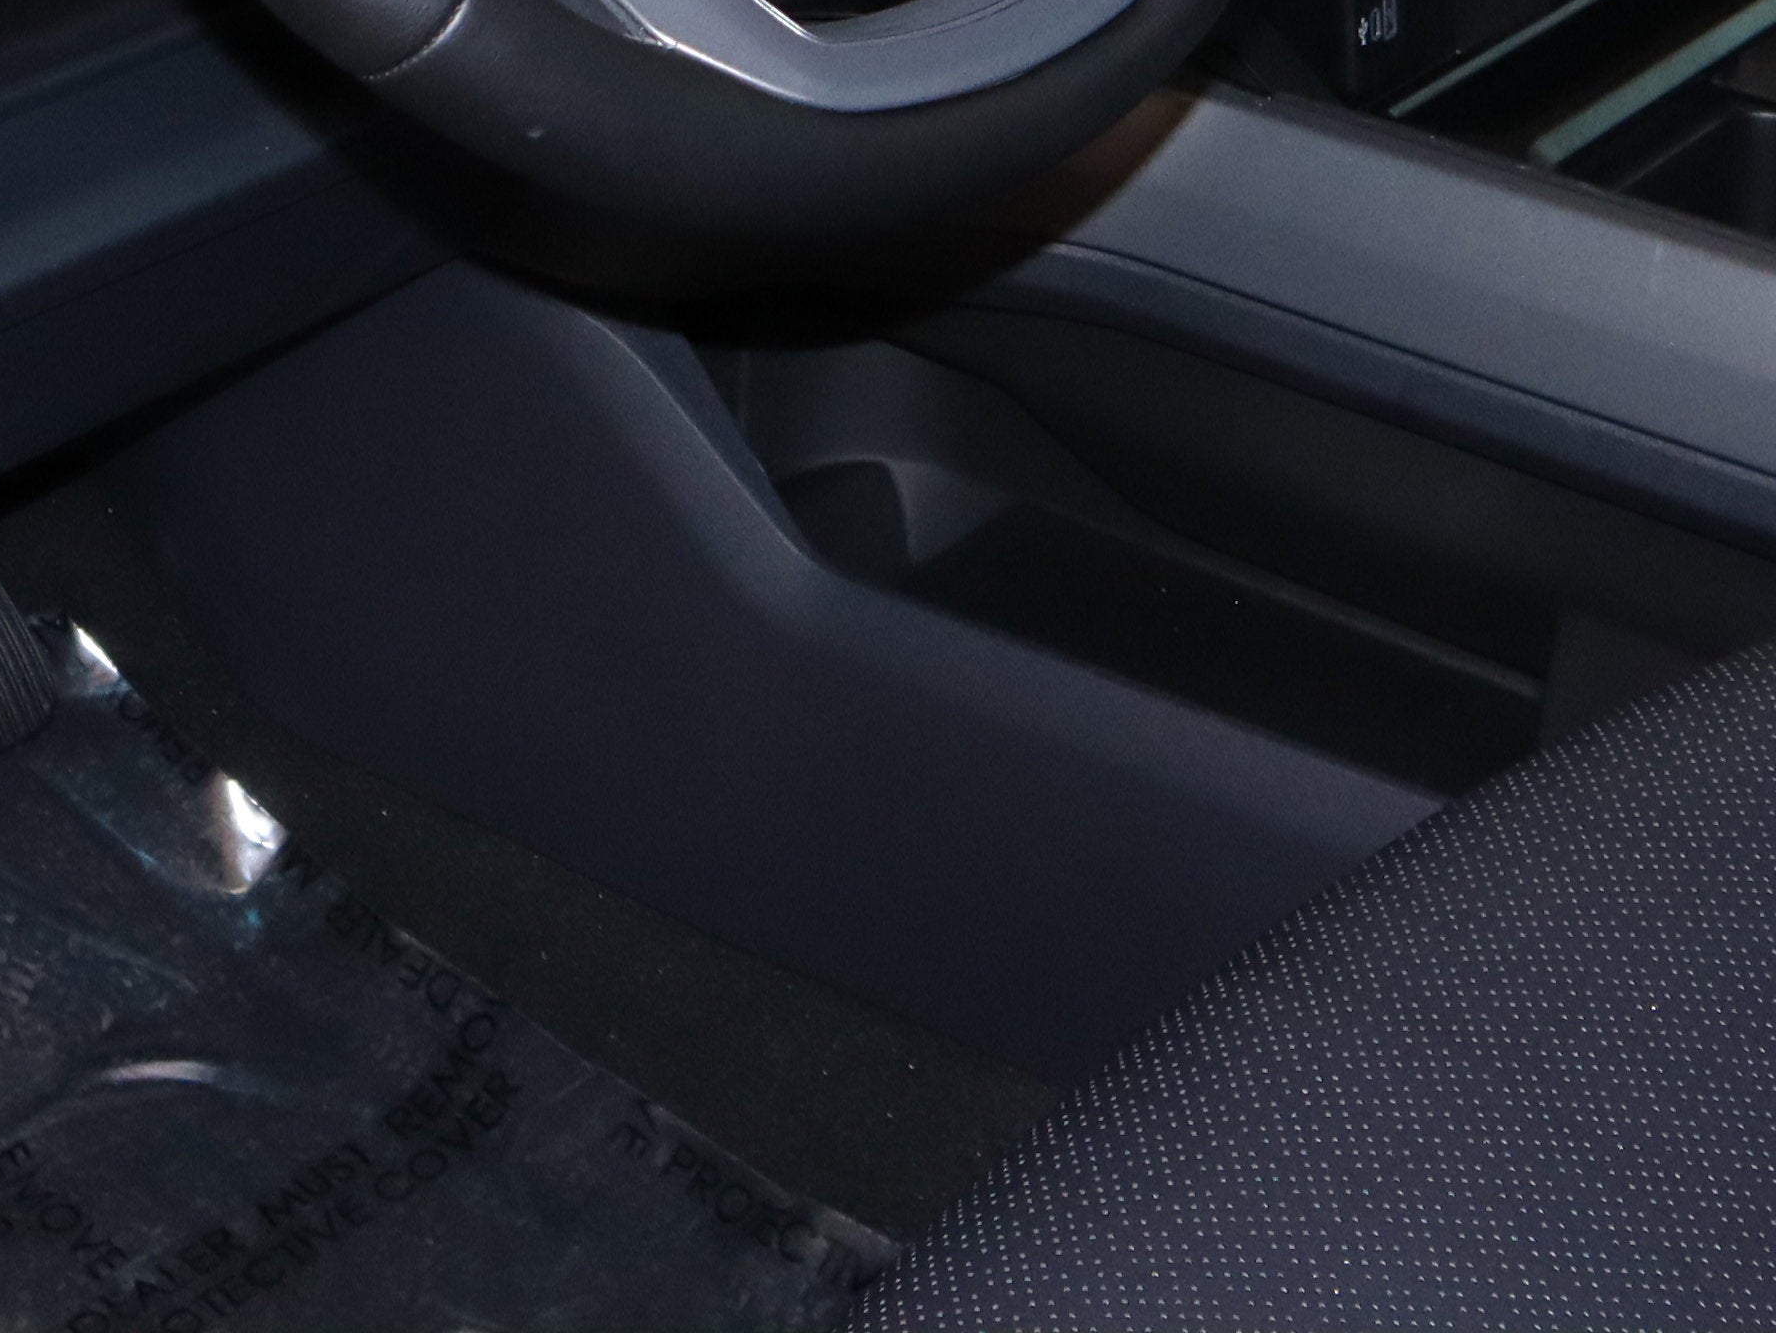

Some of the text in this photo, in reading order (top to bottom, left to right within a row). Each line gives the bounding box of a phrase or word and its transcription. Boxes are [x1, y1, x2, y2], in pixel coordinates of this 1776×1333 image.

[161, 1070, 522, 1333] OTECTIVE COVER
[256, 1142, 371, 1228] MUST
[384, 997, 509, 1139] REMO
